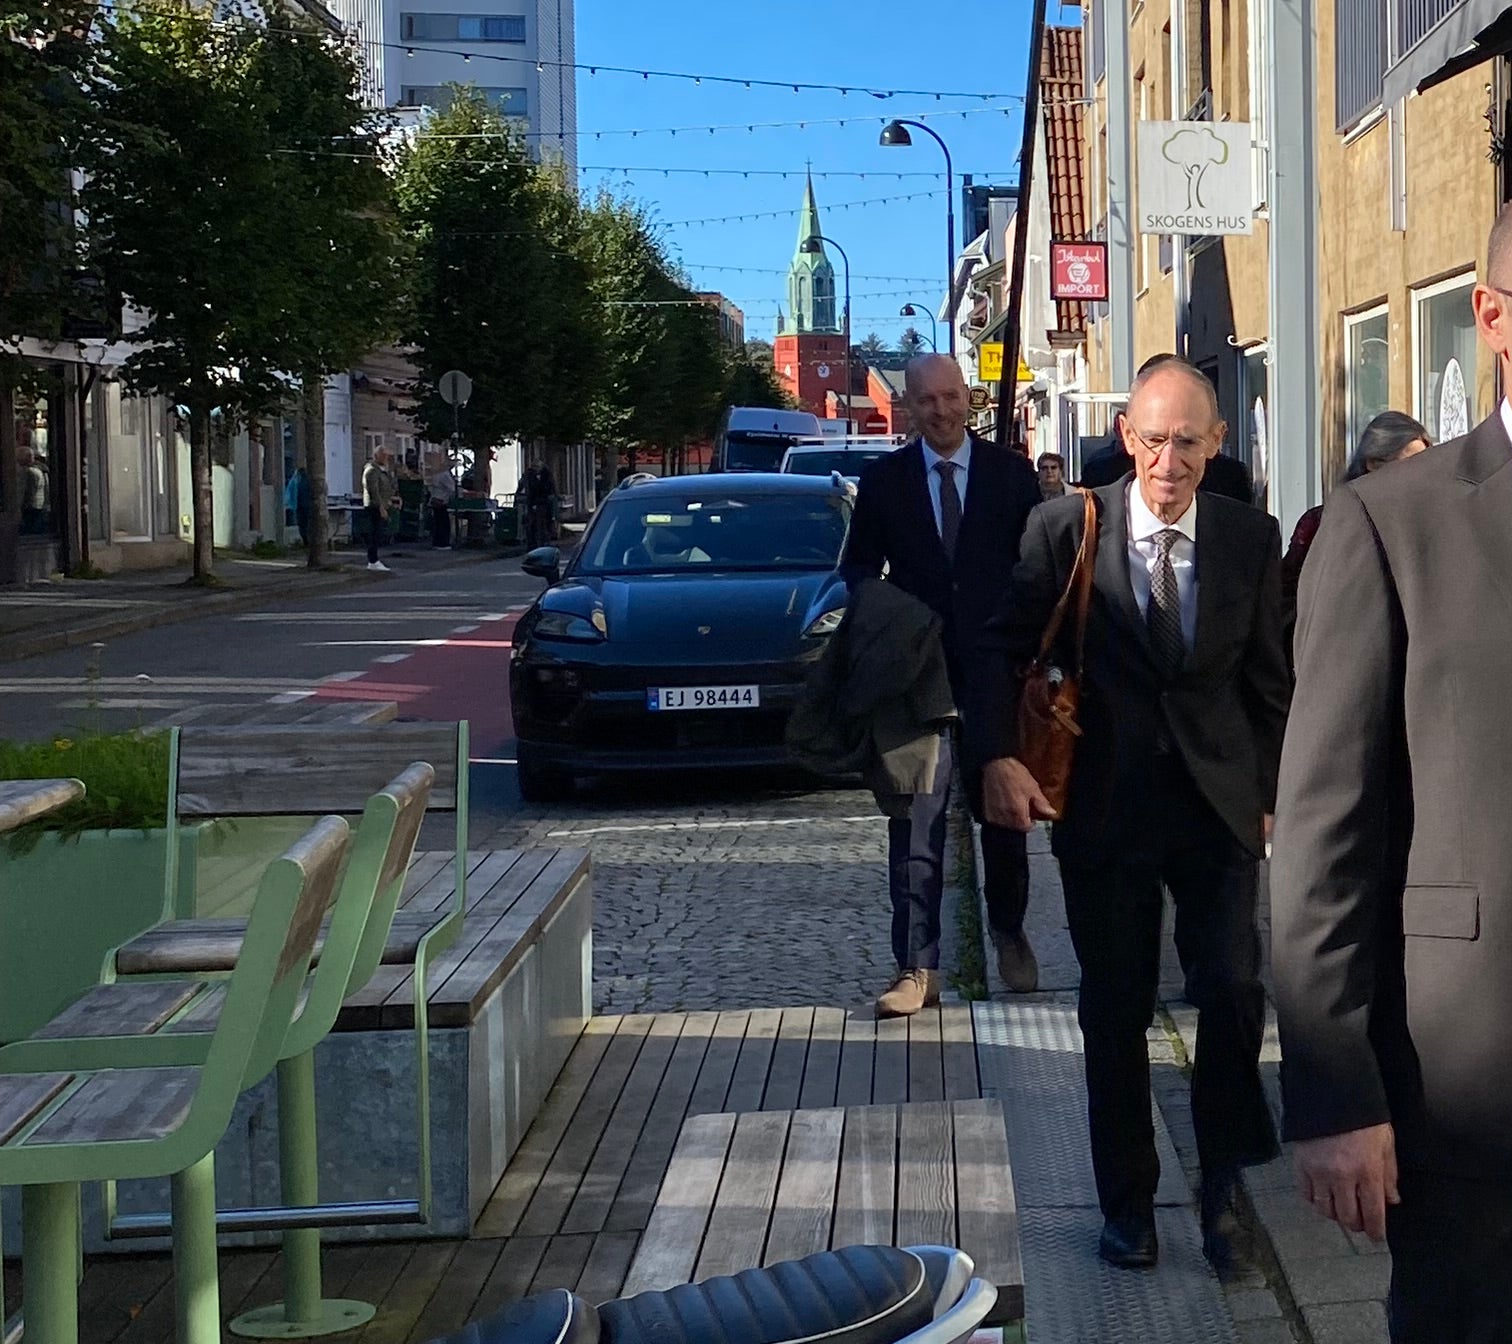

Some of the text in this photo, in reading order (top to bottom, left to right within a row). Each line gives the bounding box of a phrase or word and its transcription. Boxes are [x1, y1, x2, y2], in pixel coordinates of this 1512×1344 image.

[1146, 215, 1247, 230] SKOGENS HUS
[1057, 283, 1101, 294] IMPORT
[665, 688, 753, 707] EJ 98444
